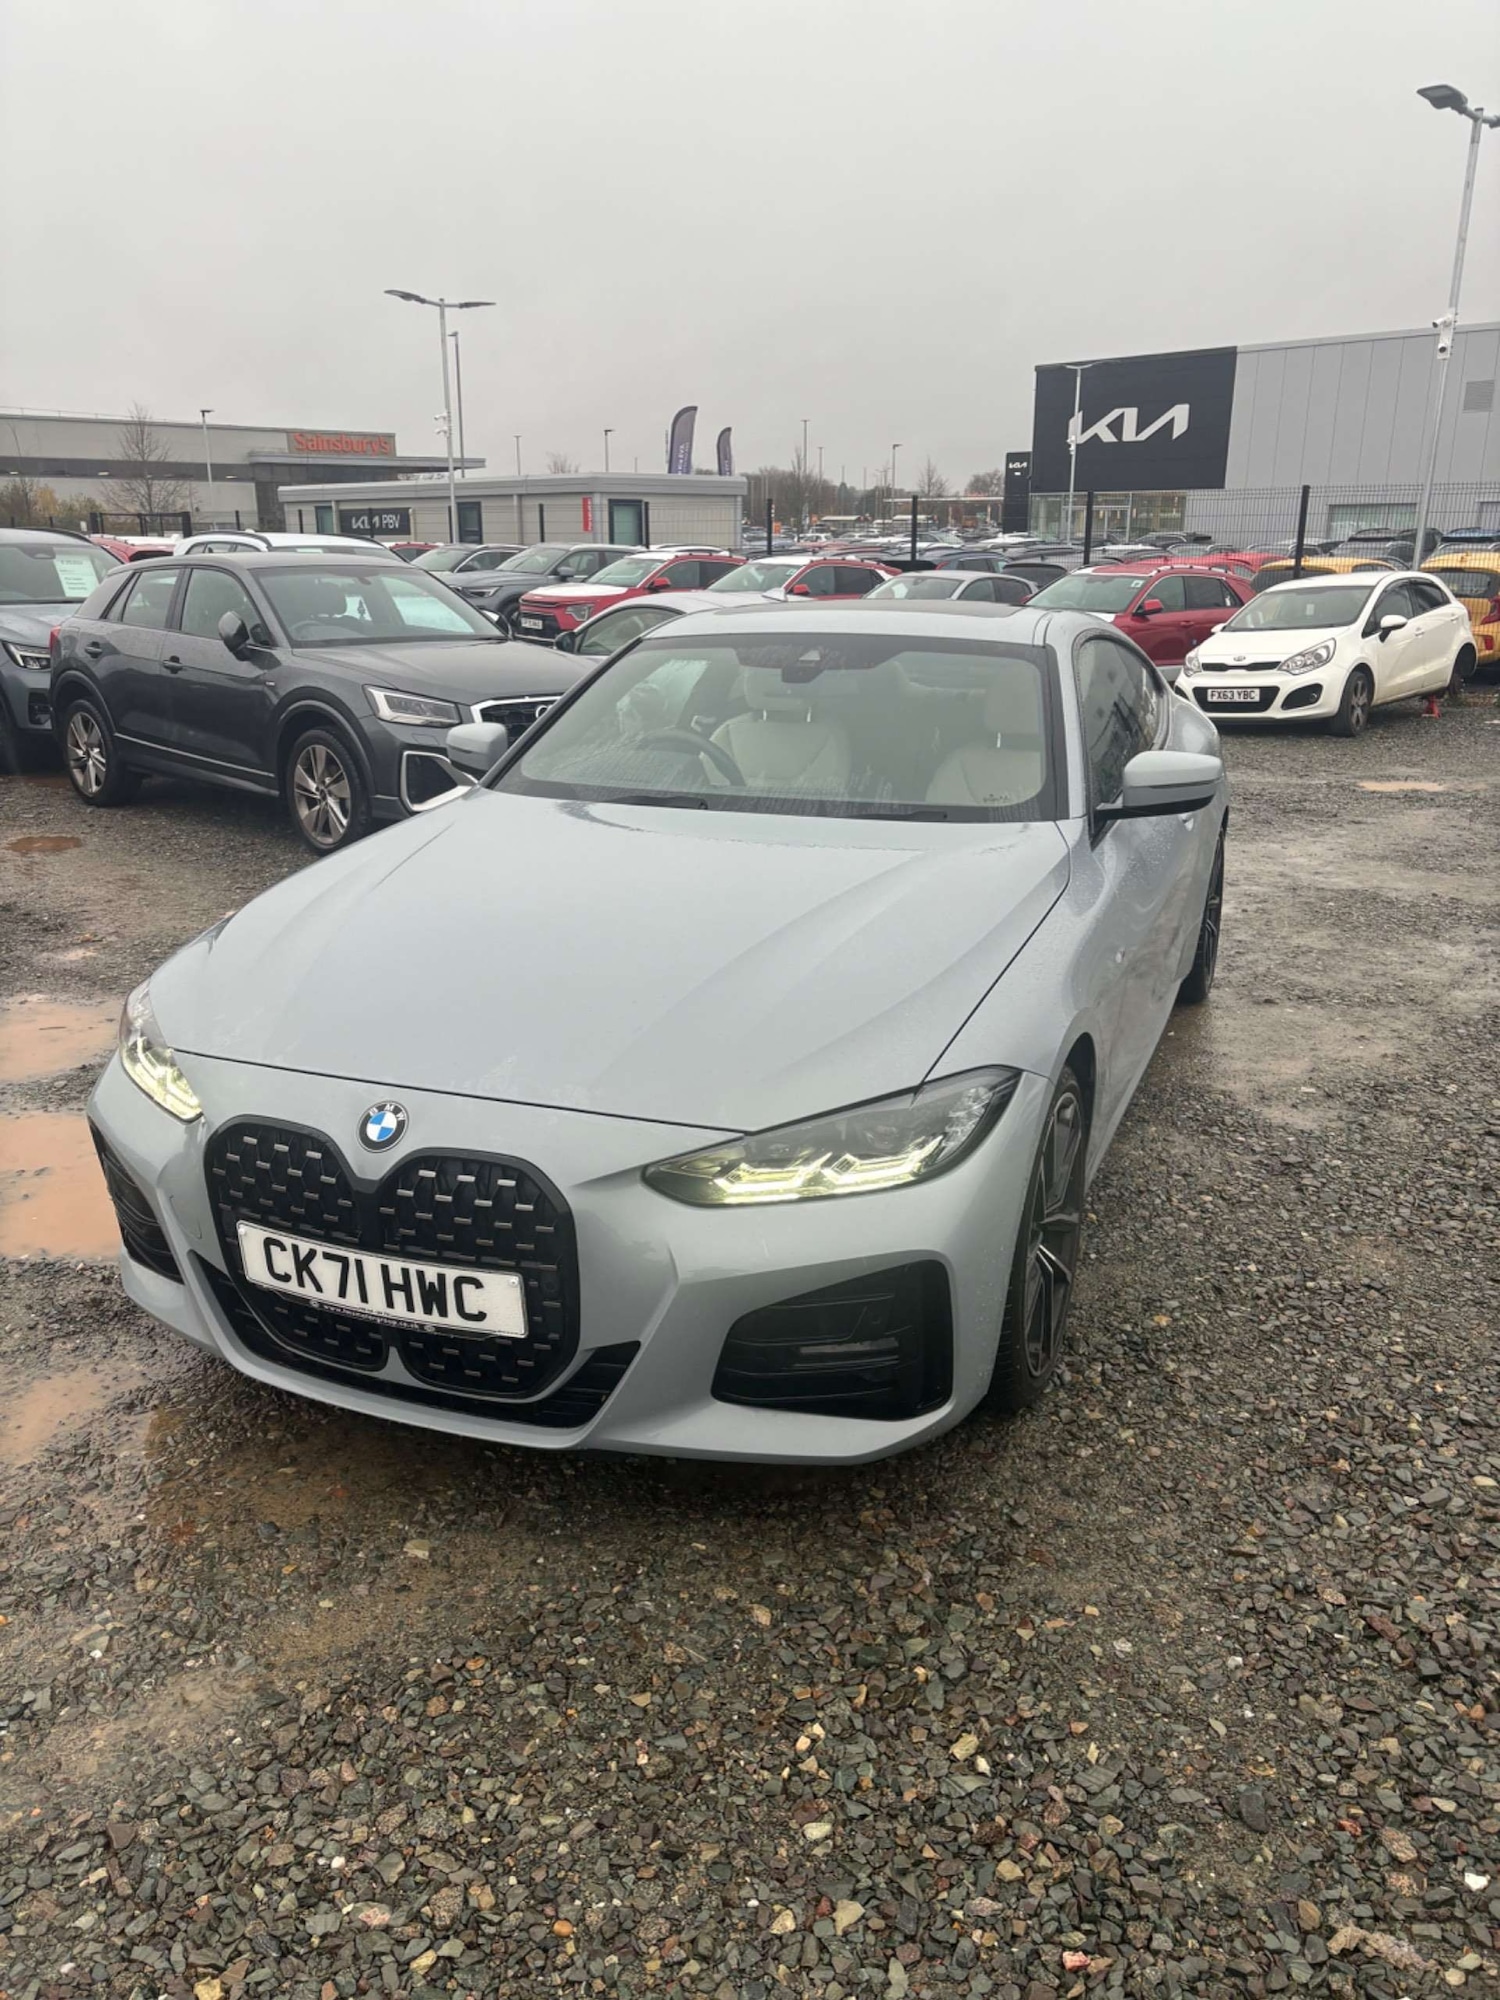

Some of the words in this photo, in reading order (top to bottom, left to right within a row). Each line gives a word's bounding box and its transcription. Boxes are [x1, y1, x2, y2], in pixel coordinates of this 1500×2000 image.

[1068, 403, 1190, 444] KIA
[294, 433, 391, 457] Sainsbury's
[381, 514, 400, 528] PBV
[1210, 690, 1235, 699] FX63
[1236, 690, 1255, 699] YBC
[368, 1103, 406, 1121] BMW
[263, 1237, 369, 1304] CK71
[380, 1263, 487, 1322] HWC
